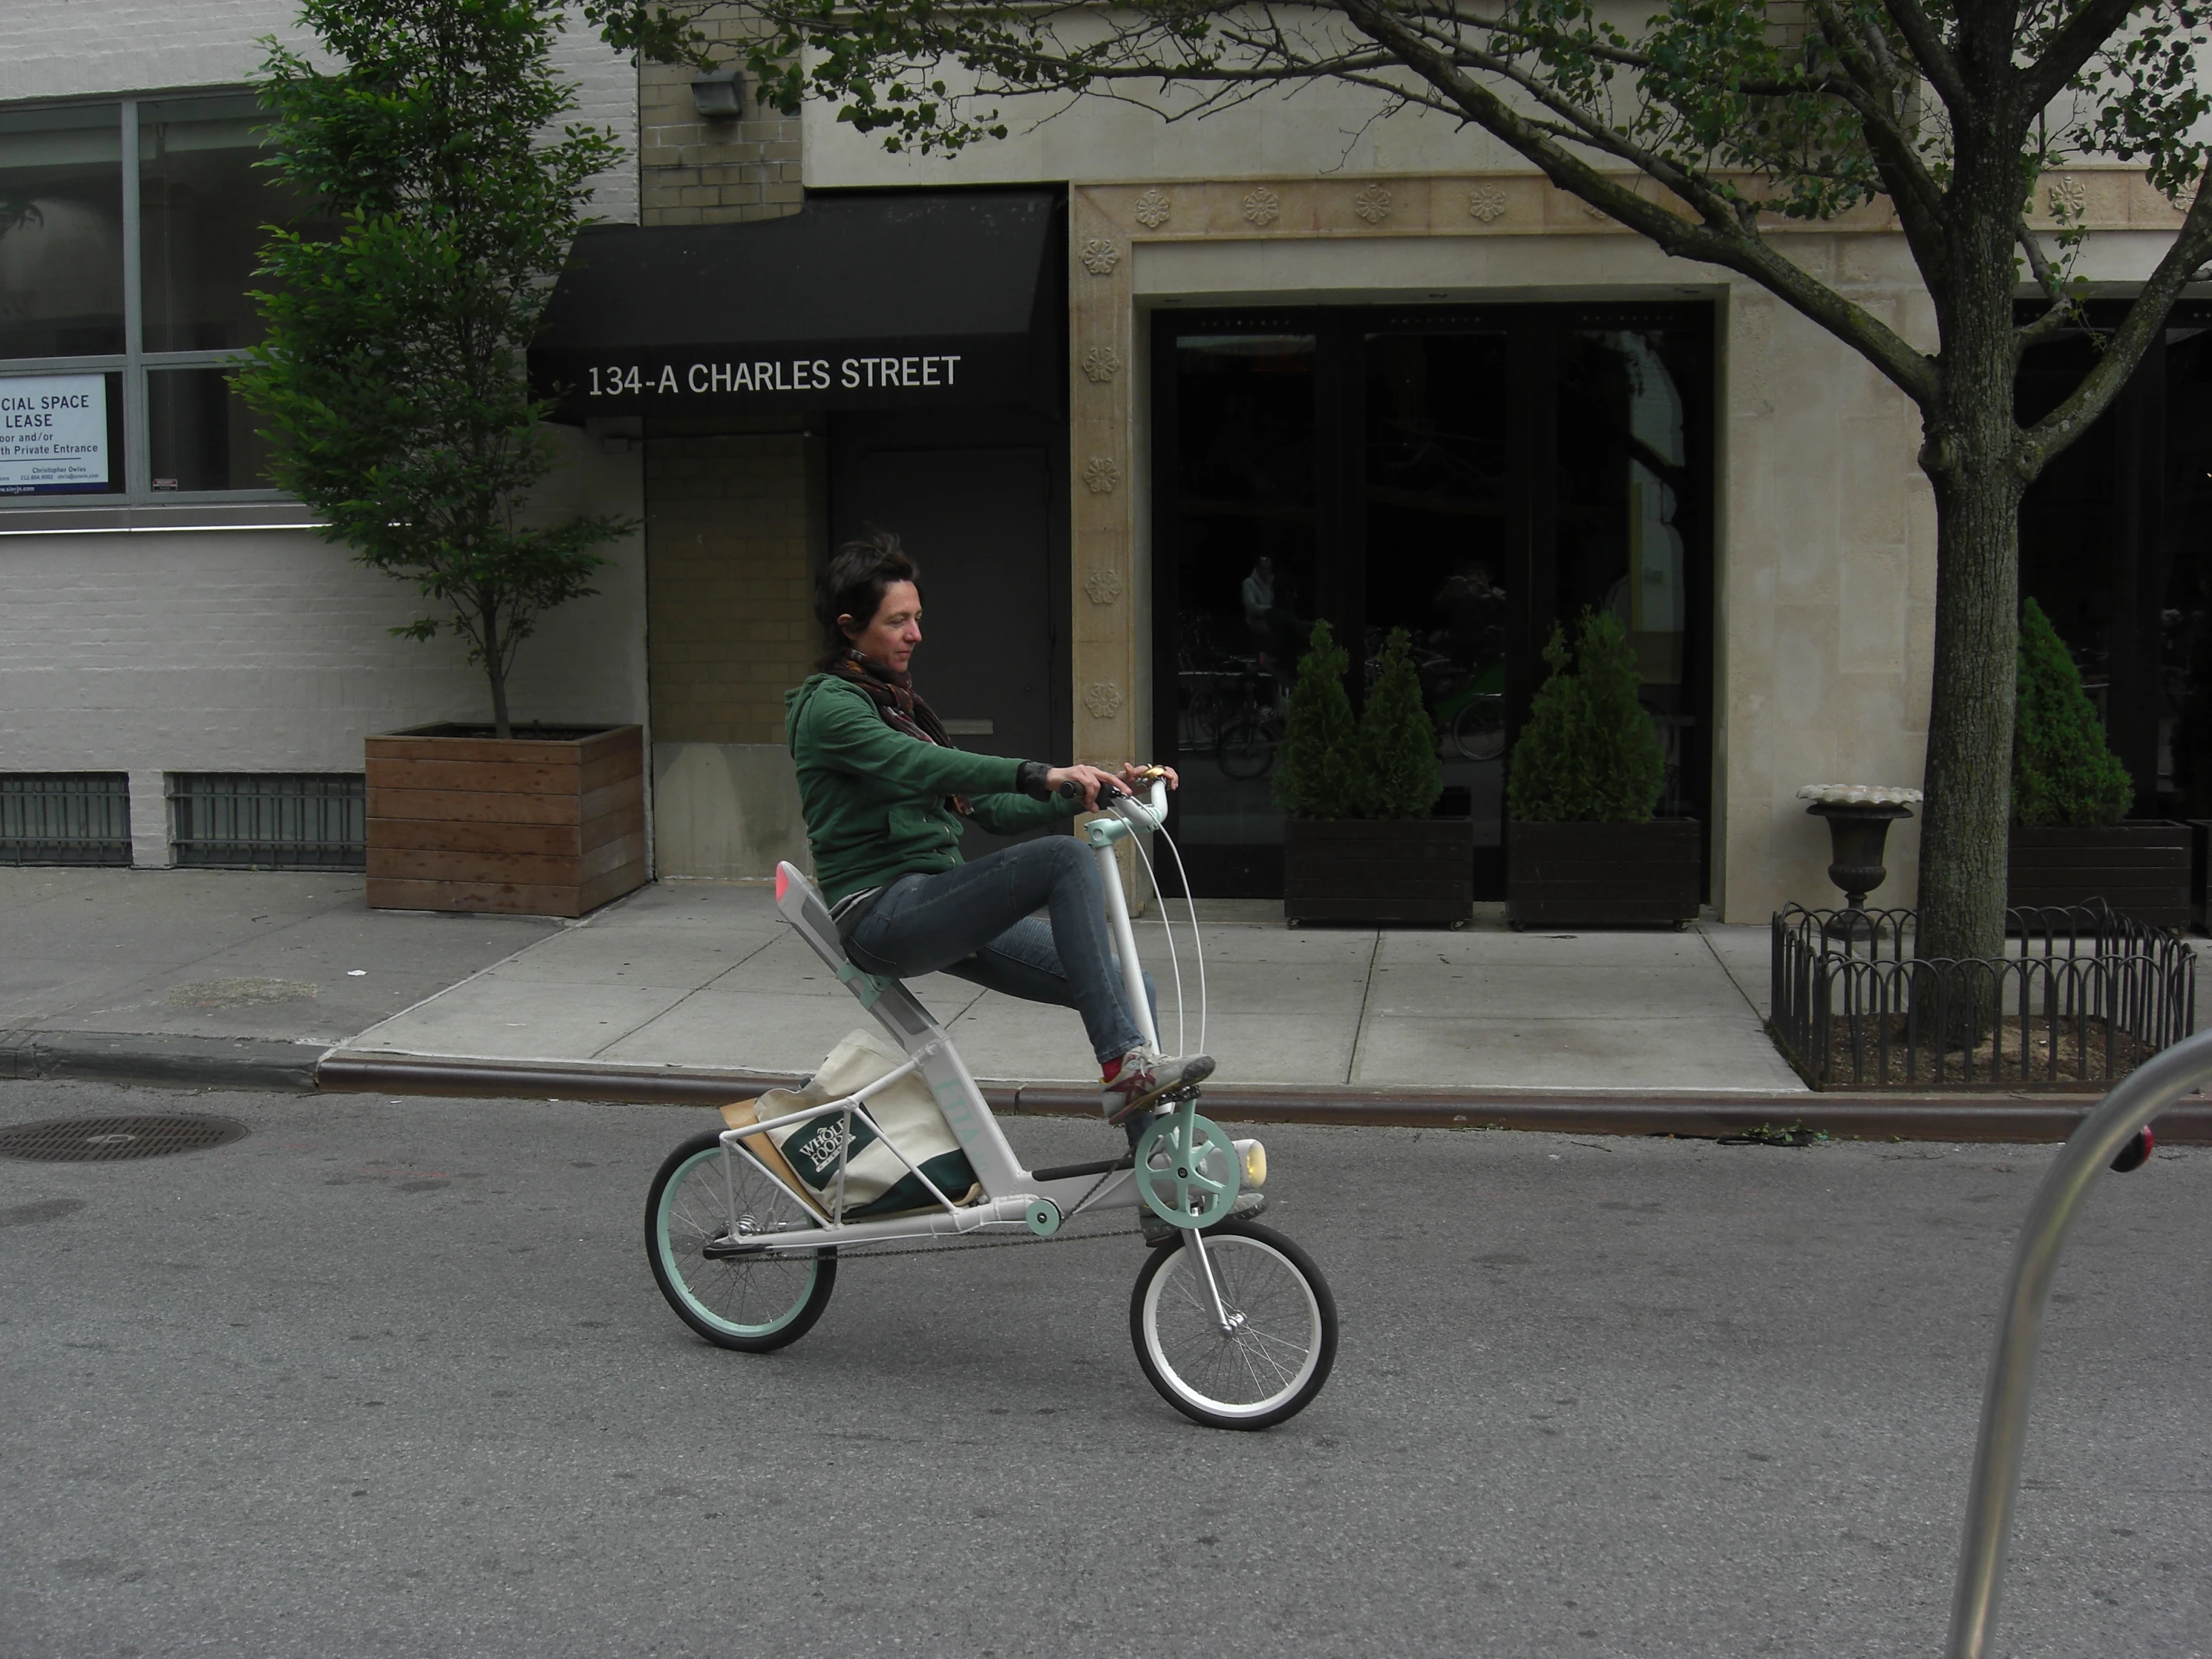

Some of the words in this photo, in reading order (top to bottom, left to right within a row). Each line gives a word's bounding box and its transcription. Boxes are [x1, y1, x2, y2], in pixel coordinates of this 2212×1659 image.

[588, 365, 679, 396] 134-A
[687, 359, 830, 393] CHARLES
[840, 355, 962, 389] STREET
[2, 397, 35, 411] CIAL
[41, 395, 89, 409] SPACE
[5, 414, 52, 428] LEASE
[18, 432, 54, 442] and/or
[14, 445, 50, 455] Private
[53, 444, 98, 453] Entrance
[32, 466, 66, 475] Christopher
[810, 1134, 852, 1167] FOOD
